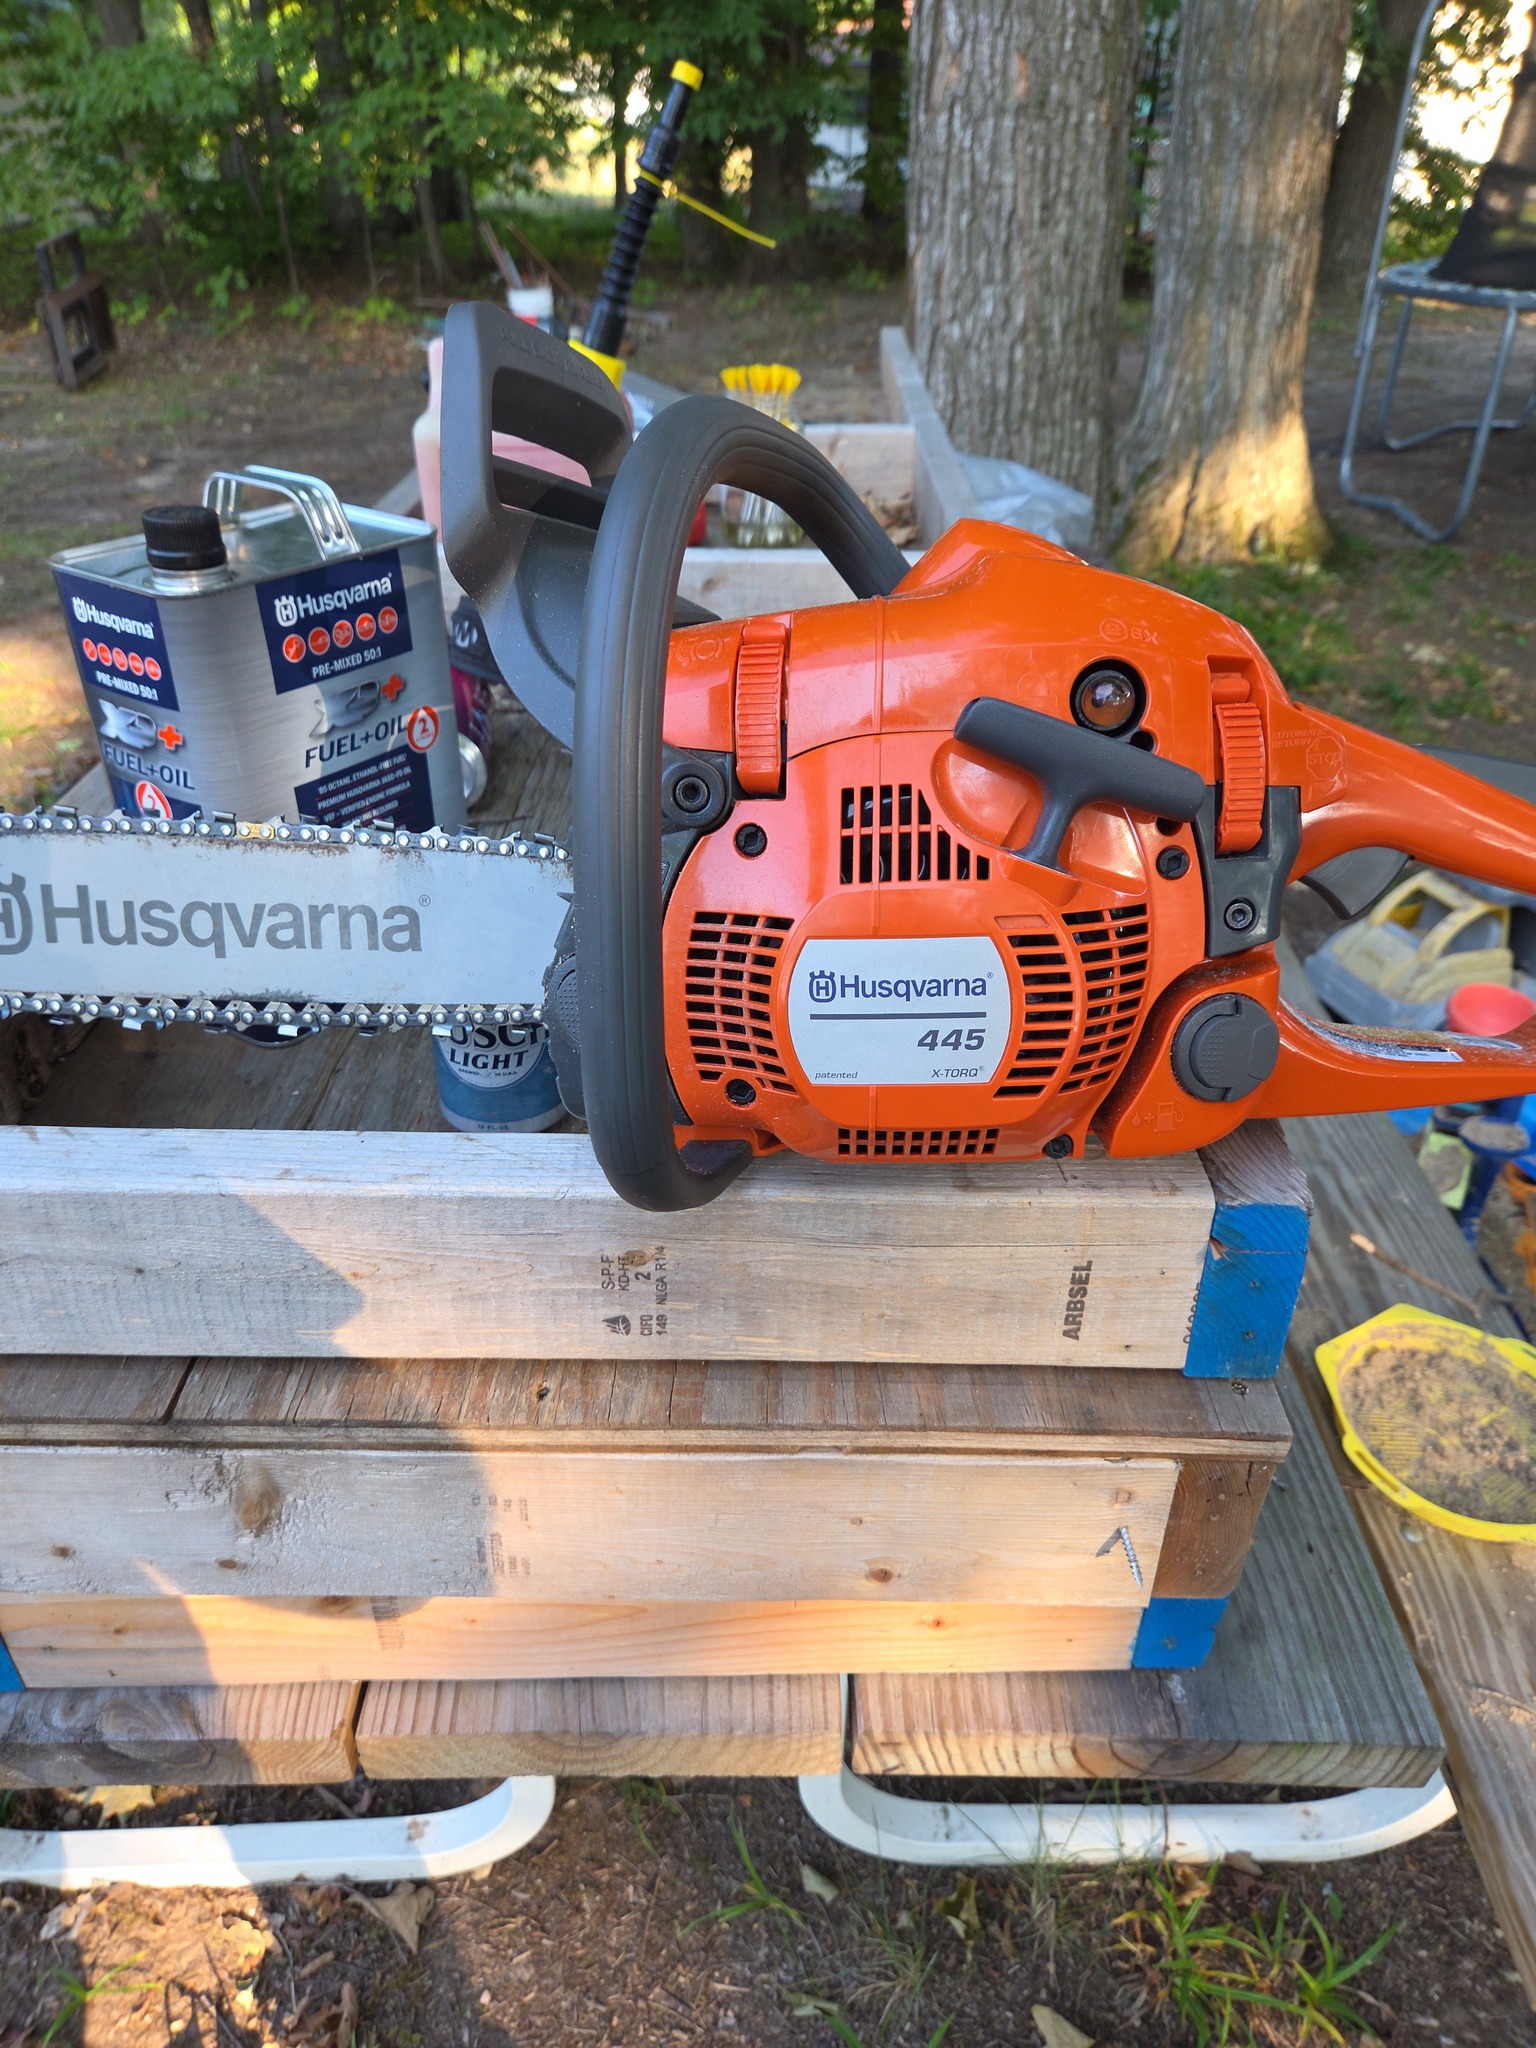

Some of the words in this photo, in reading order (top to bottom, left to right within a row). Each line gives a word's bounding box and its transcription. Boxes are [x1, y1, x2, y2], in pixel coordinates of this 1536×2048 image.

[296, 576, 393, 619] Husqvarna
[86, 603, 155, 640] Husqvarna
[311, 653, 363, 679] PRE-MIXED
[363, 646, 382, 662] 50:1
[95, 670, 140, 696] PRE-MIXED
[417, 717, 430, 736] 2
[1271, 728, 1327, 740] AUTOMATIC
[304, 714, 408, 769] FUEL+OIL
[1271, 738, 1312, 750] RETURN
[103, 743, 196, 791] FUEL+OIL
[1309, 751, 1341, 765] STOP
[41, 883, 423, 960] Husqvarna
[840, 974, 987, 1002] Husqvarna
[917, 1028, 986, 1051] 445
[450, 1048, 529, 1070] LIGHT
[814, 1071, 858, 1081] patented
[931, 1067, 979, 1079] X-TORQ
[601, 1255, 616, 1290] S-P-F
[617, 1254, 630, 1291] KD-HT
[634, 1271, 651, 1281] 2
[655, 1276, 668, 1306] NLGA
[1062, 1259, 1093, 1341] ARBSEL
[656, 1314, 668, 1336] 149
